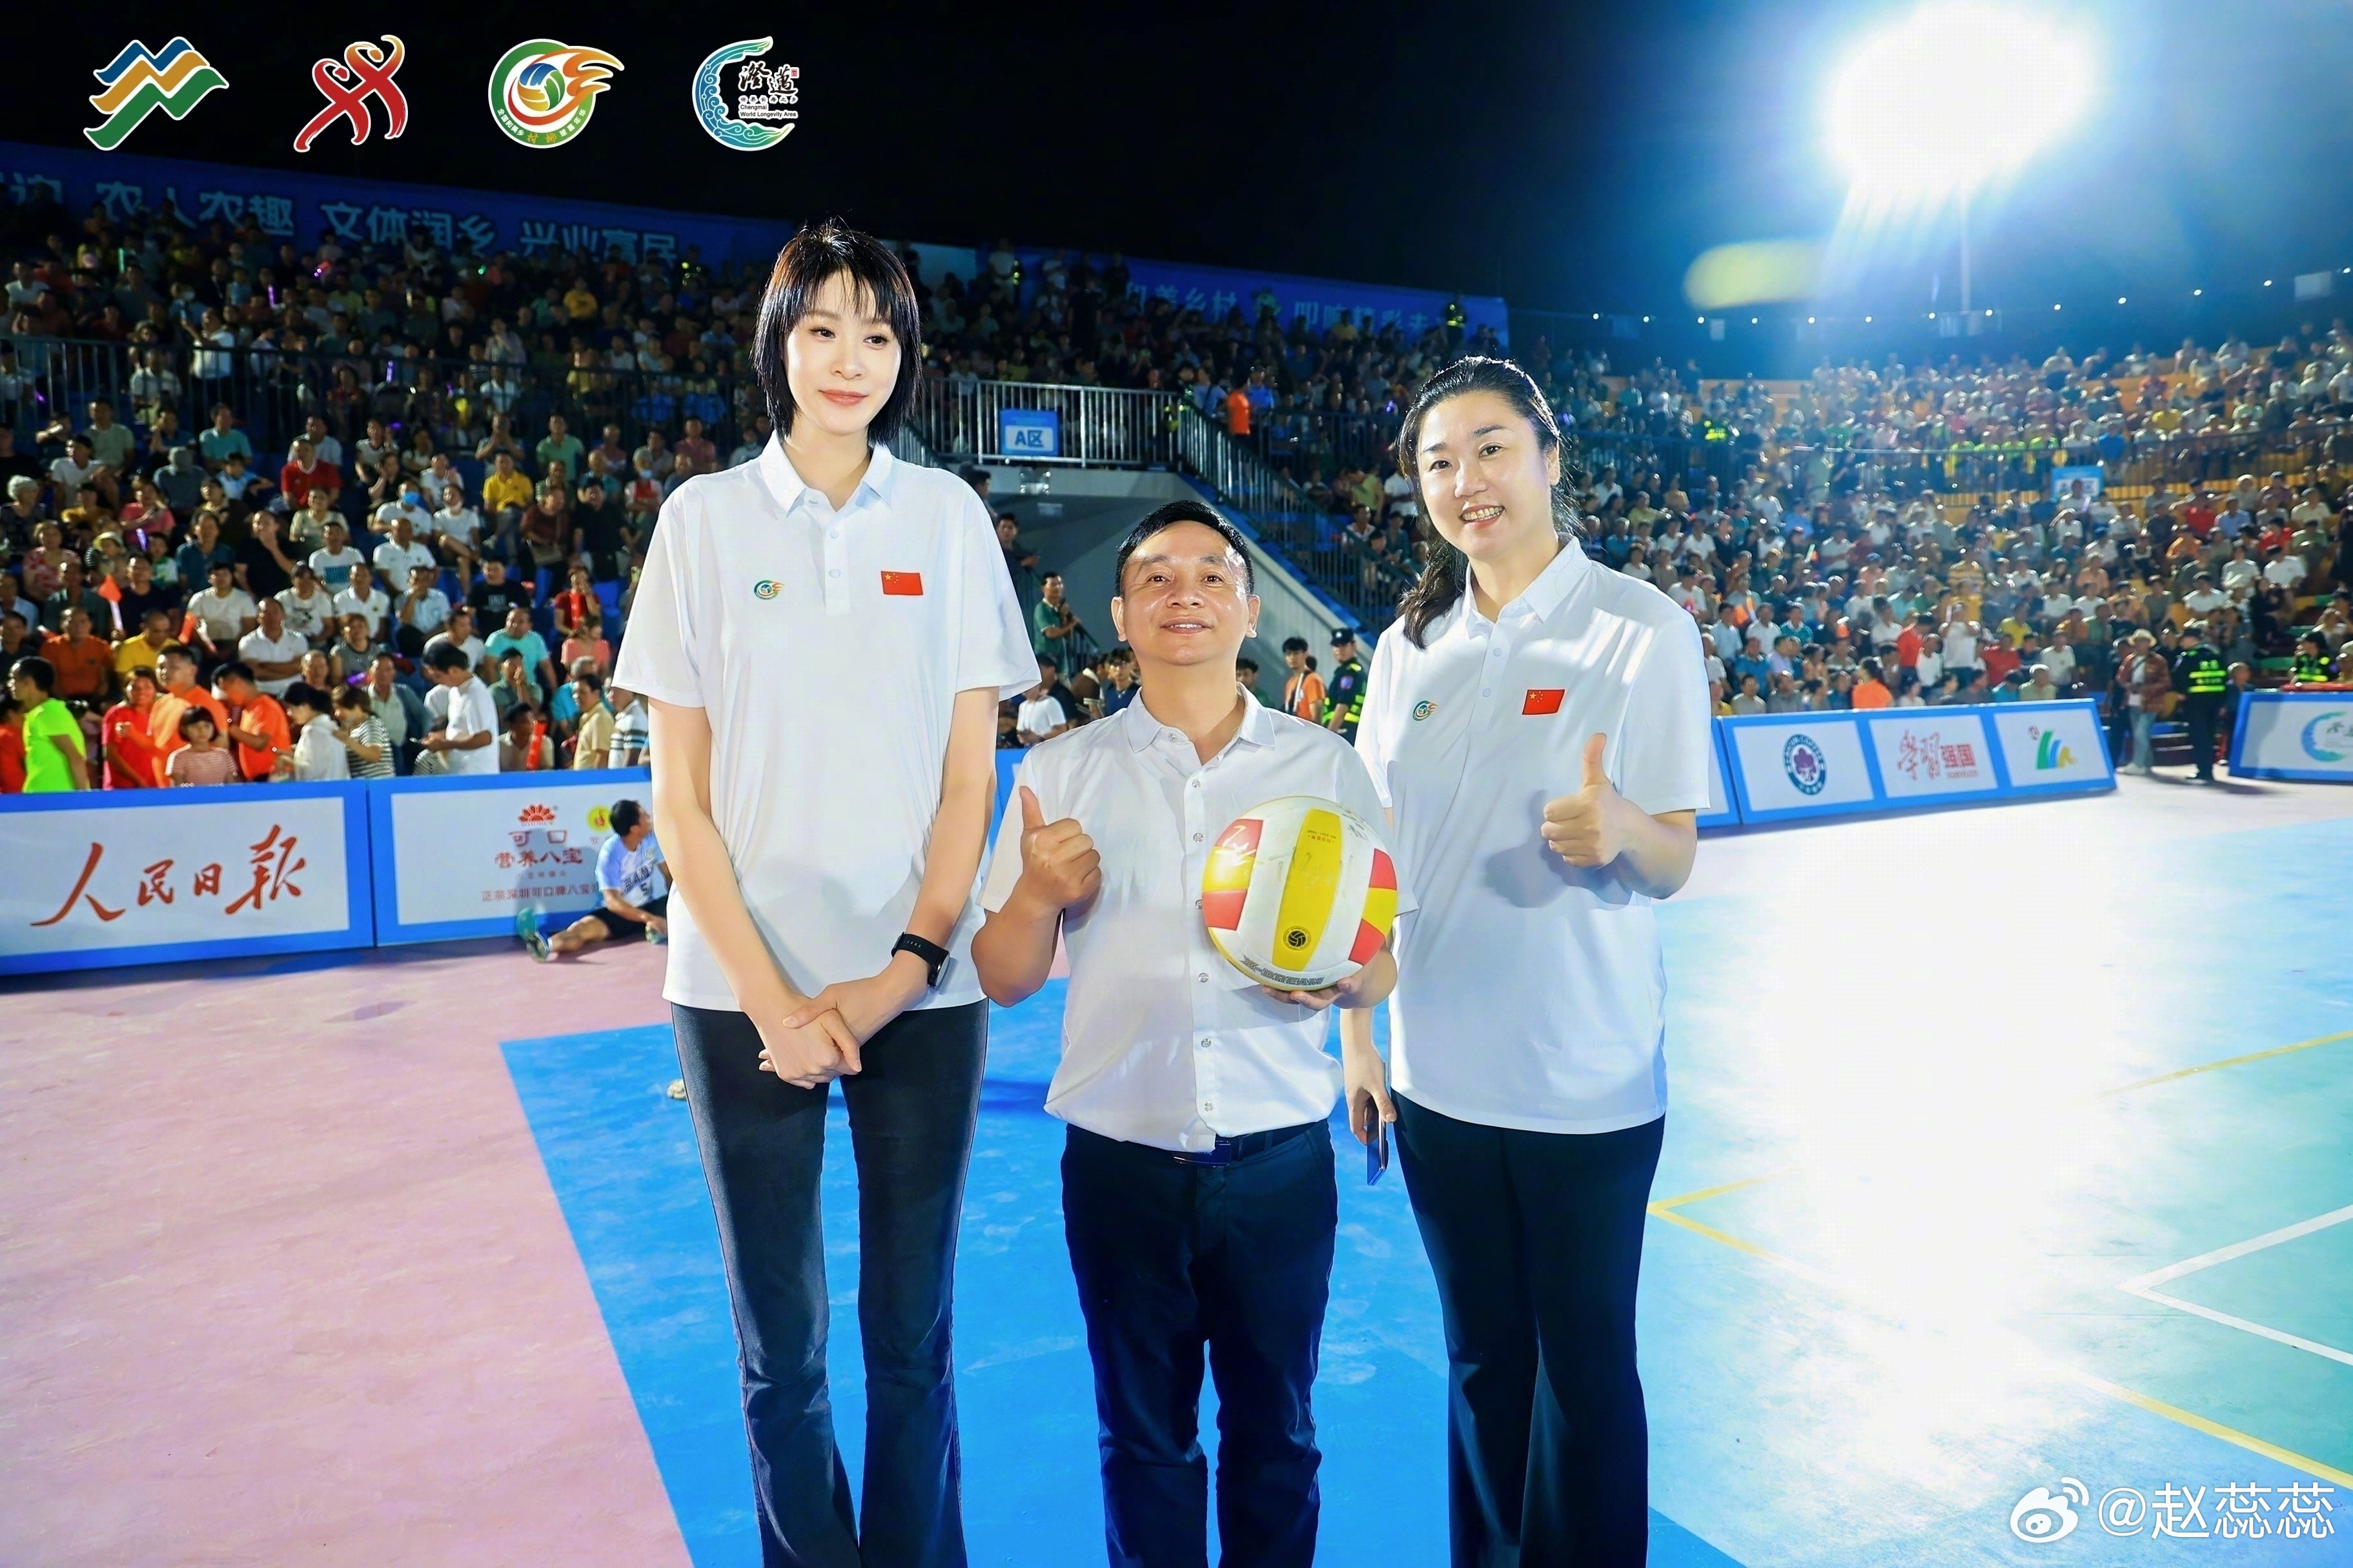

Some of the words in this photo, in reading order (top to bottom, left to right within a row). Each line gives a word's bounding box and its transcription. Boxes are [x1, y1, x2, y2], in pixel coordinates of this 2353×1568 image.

[1014, 429, 1044, 448] A区
[508, 830, 567, 847] 可口
[1239, 954, 1324, 986] X-DREAM
